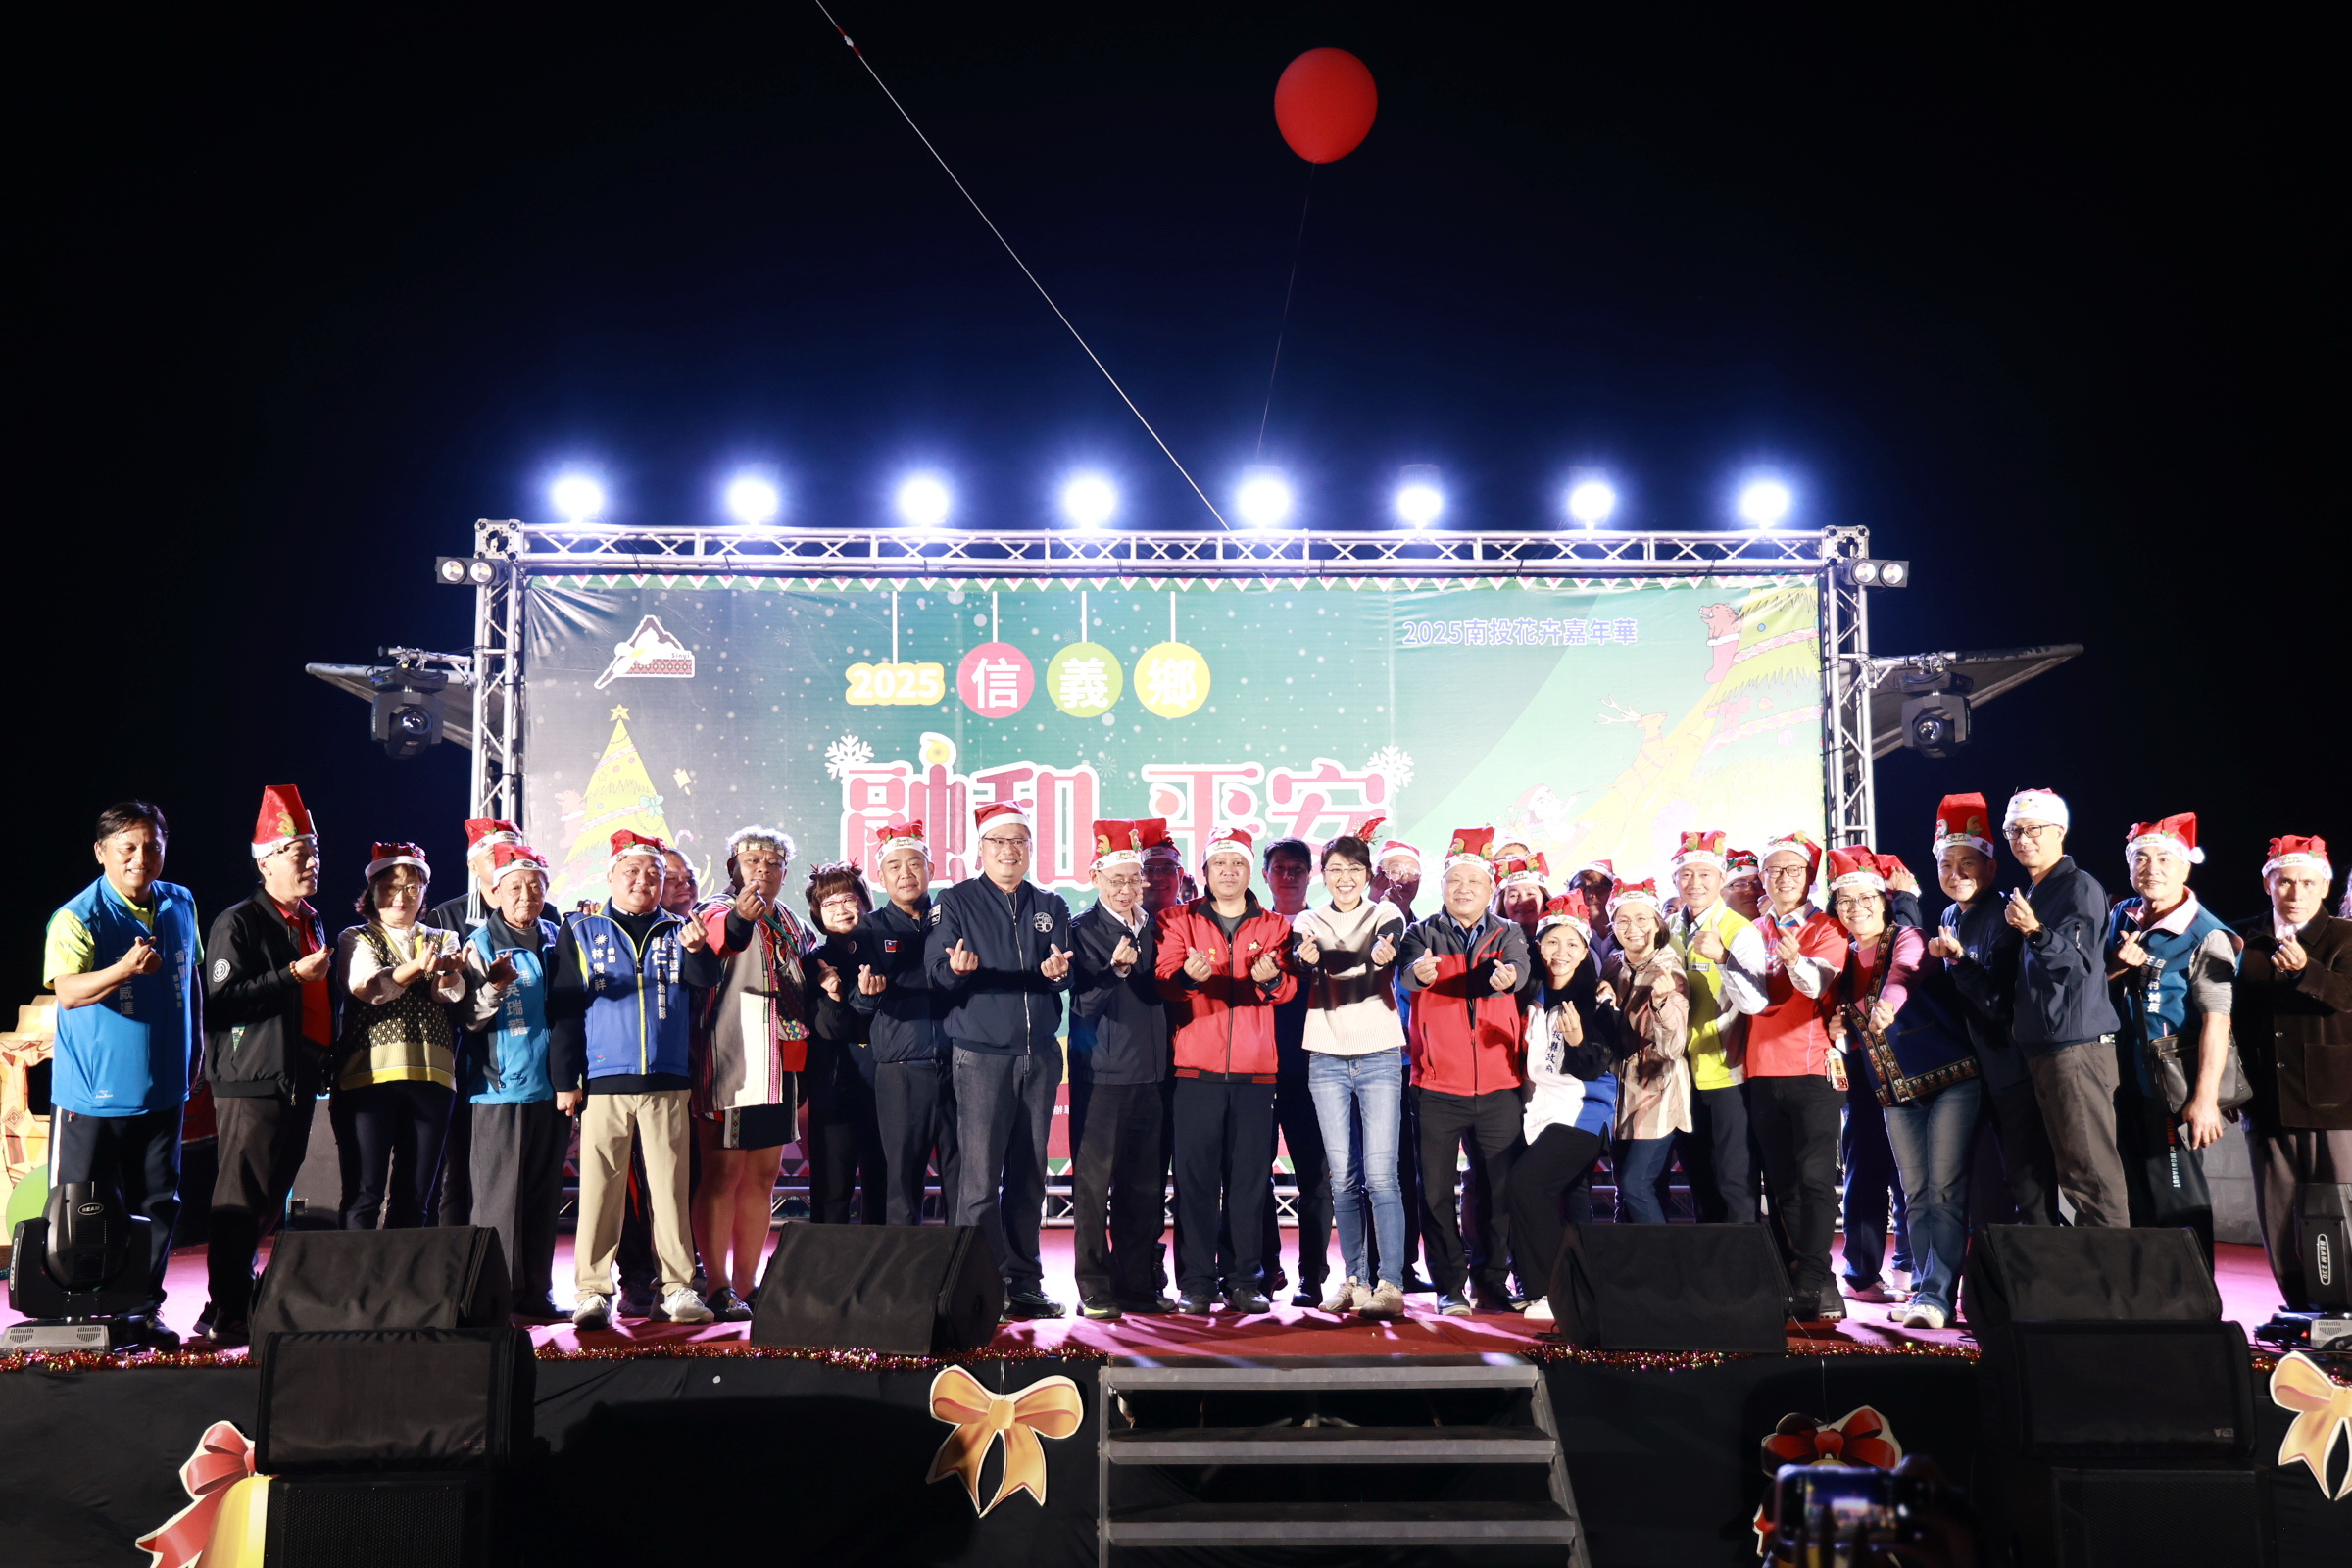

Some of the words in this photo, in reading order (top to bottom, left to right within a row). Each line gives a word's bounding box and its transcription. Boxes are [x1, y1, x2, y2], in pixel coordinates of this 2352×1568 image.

[1402, 618, 1638, 645] 2025南投花卉嘉年華
[852, 669, 939, 698] 2025
[971, 657, 1197, 708] 信義鄉
[1143, 760, 1390, 888] 平安
[2170, 1152, 2180, 1188] MONTAGUT
